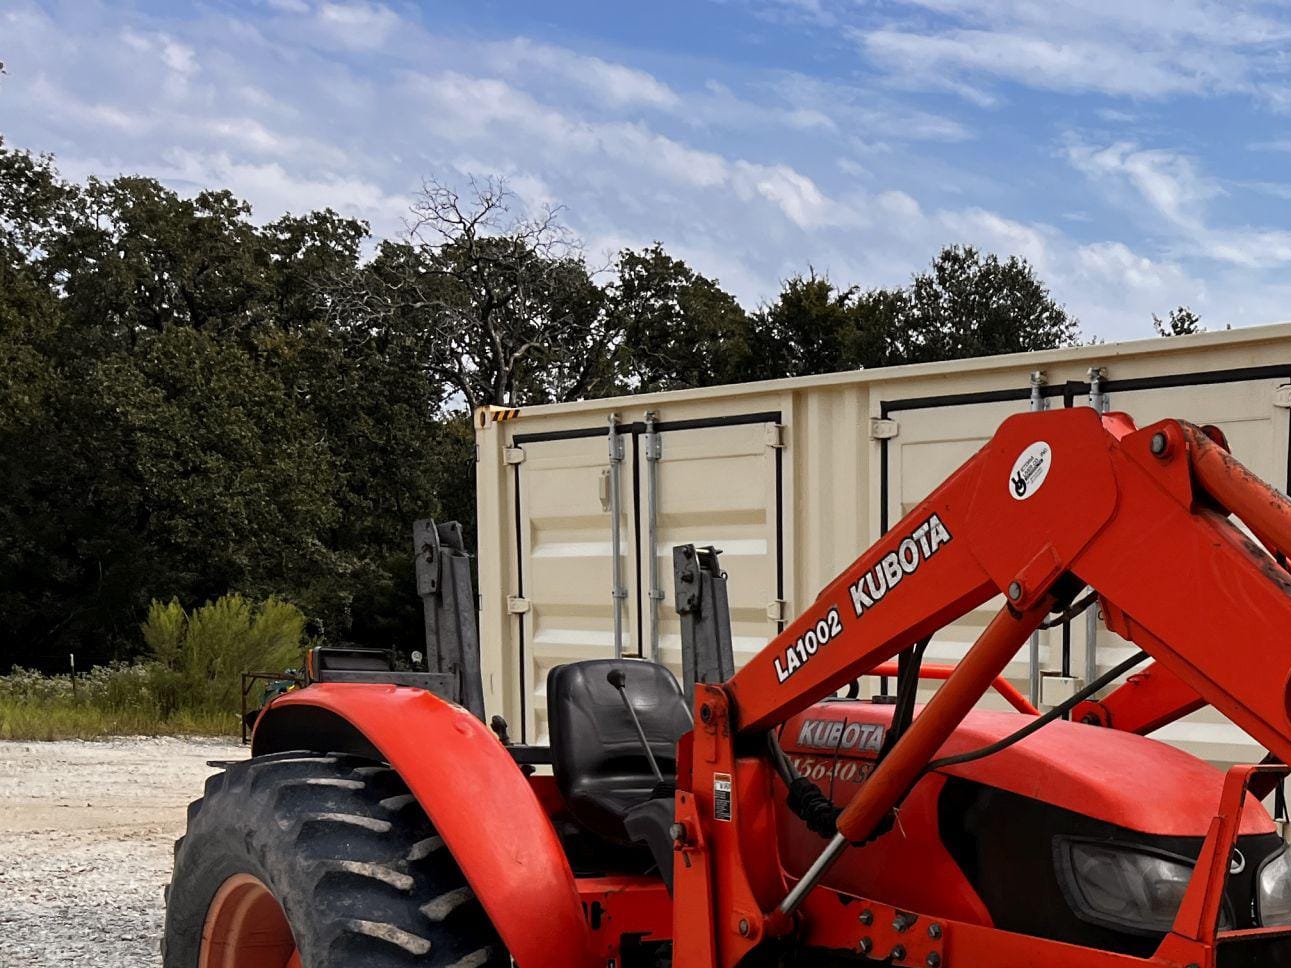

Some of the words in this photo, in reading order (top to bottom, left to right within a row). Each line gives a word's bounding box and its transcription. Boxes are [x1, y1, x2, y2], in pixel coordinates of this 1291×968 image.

[774, 608, 843, 683] LA1002
[849, 513, 952, 617] KUBOTA
[797, 719, 886, 753] KUBOTA
